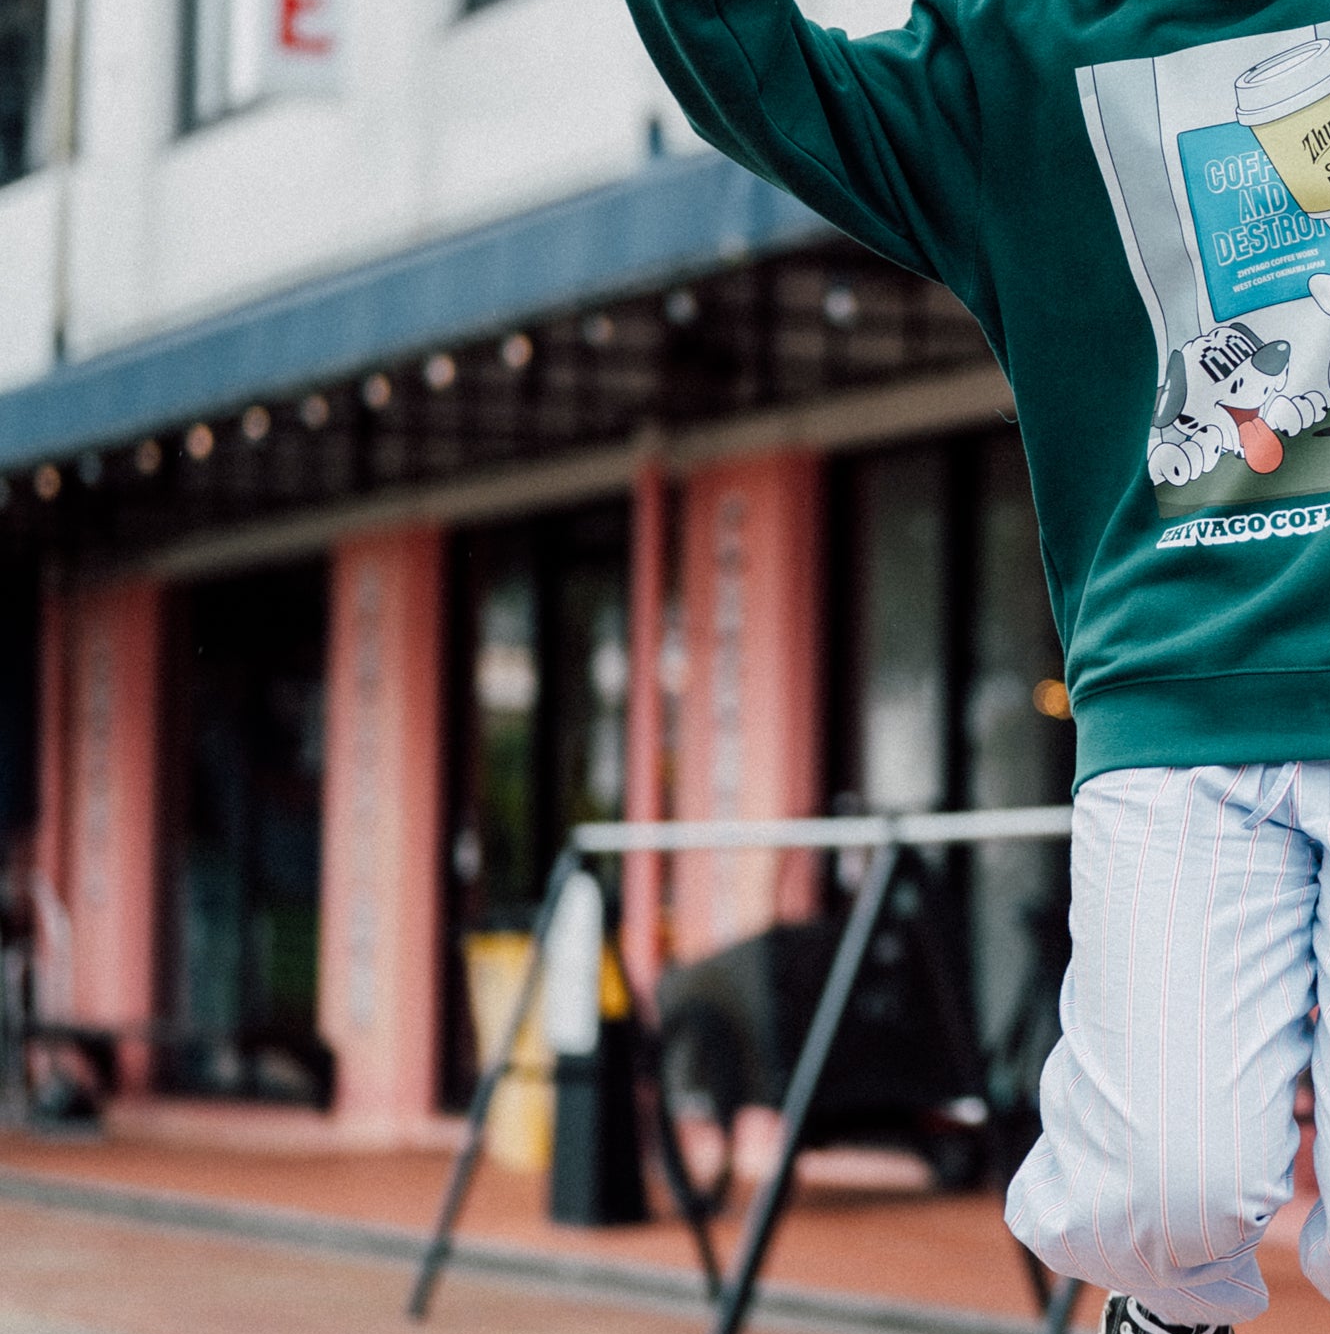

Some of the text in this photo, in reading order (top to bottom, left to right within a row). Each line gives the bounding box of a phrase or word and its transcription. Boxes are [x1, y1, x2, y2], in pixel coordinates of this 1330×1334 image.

[1205, 149, 1278, 193] COFF
[1239, 181, 1288, 224] AND
[1232, 259, 1326, 293] WEST COAST OKINAWA JAPAN
[1237, 248, 1319, 278] ZHYVAGO COFFEE WORKS
[1159, 514, 1266, 544] ZHYVAGO
